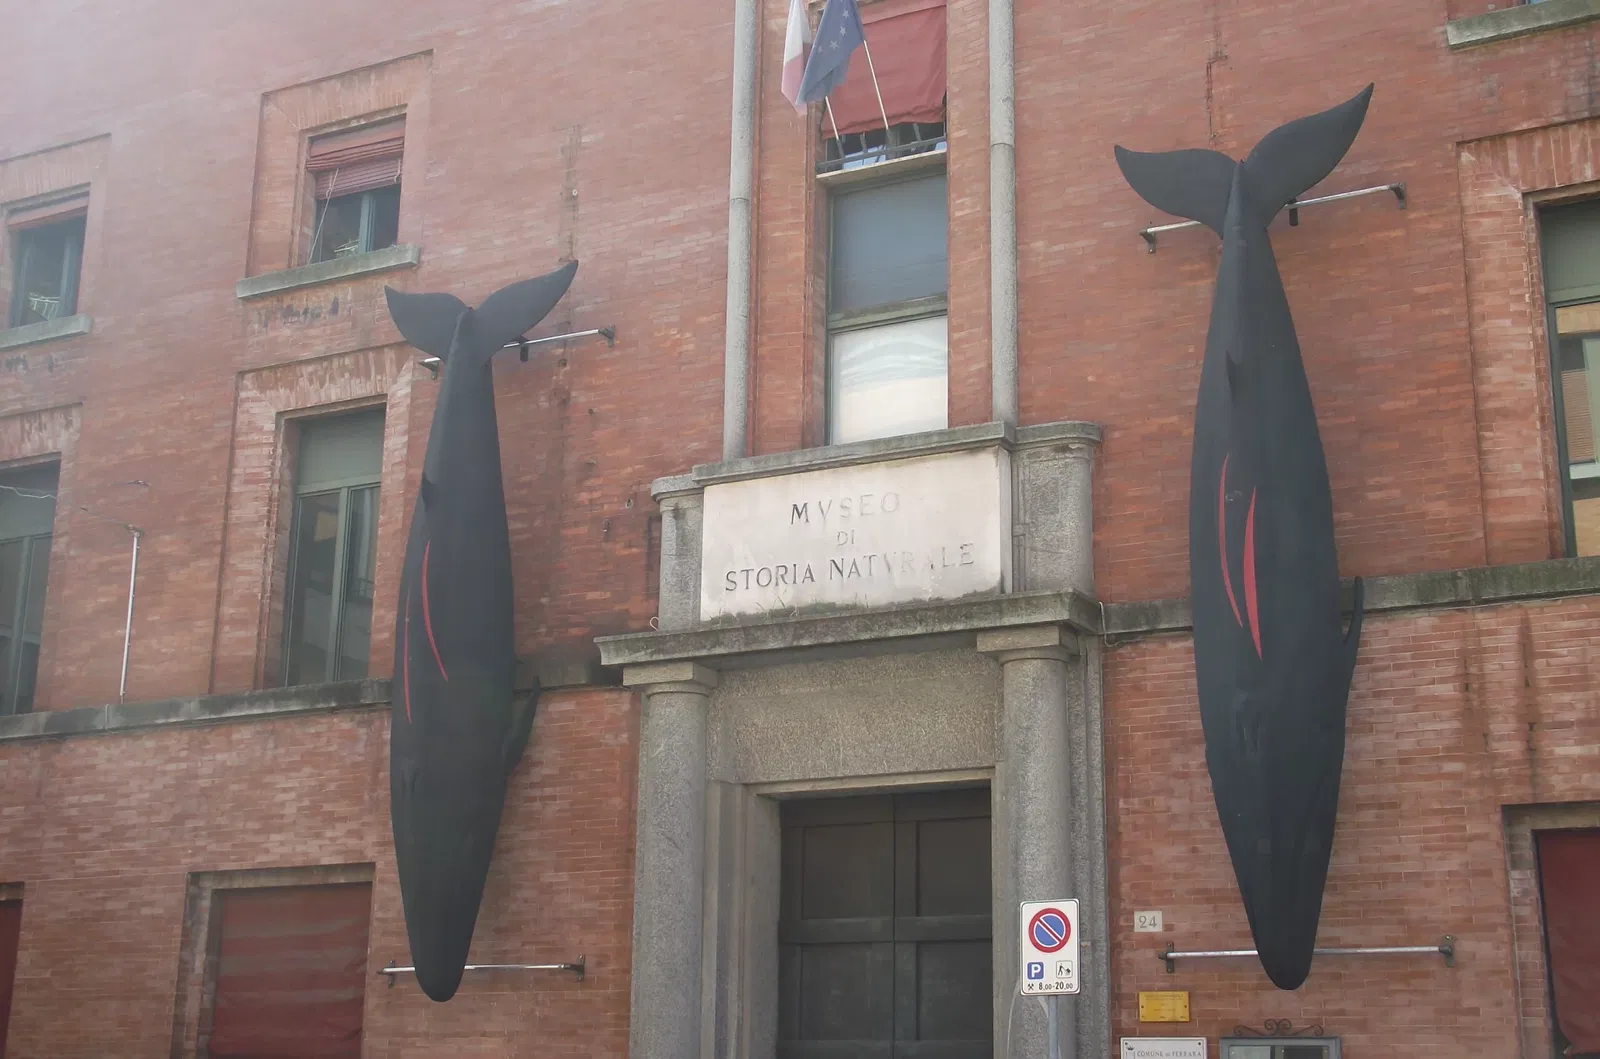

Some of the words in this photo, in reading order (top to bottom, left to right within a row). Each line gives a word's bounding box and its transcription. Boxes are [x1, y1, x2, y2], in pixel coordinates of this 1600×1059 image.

[790, 491, 899, 526] MVSEO
[836, 529, 854, 547] DI
[725, 563, 816, 592] STORIA
[1139, 915, 1157, 929] 24
[1031, 963, 1042, 978] P
[1136, 1050, 1164, 1058] COMUNE
[1172, 1050, 1202, 1058] FERRARA
